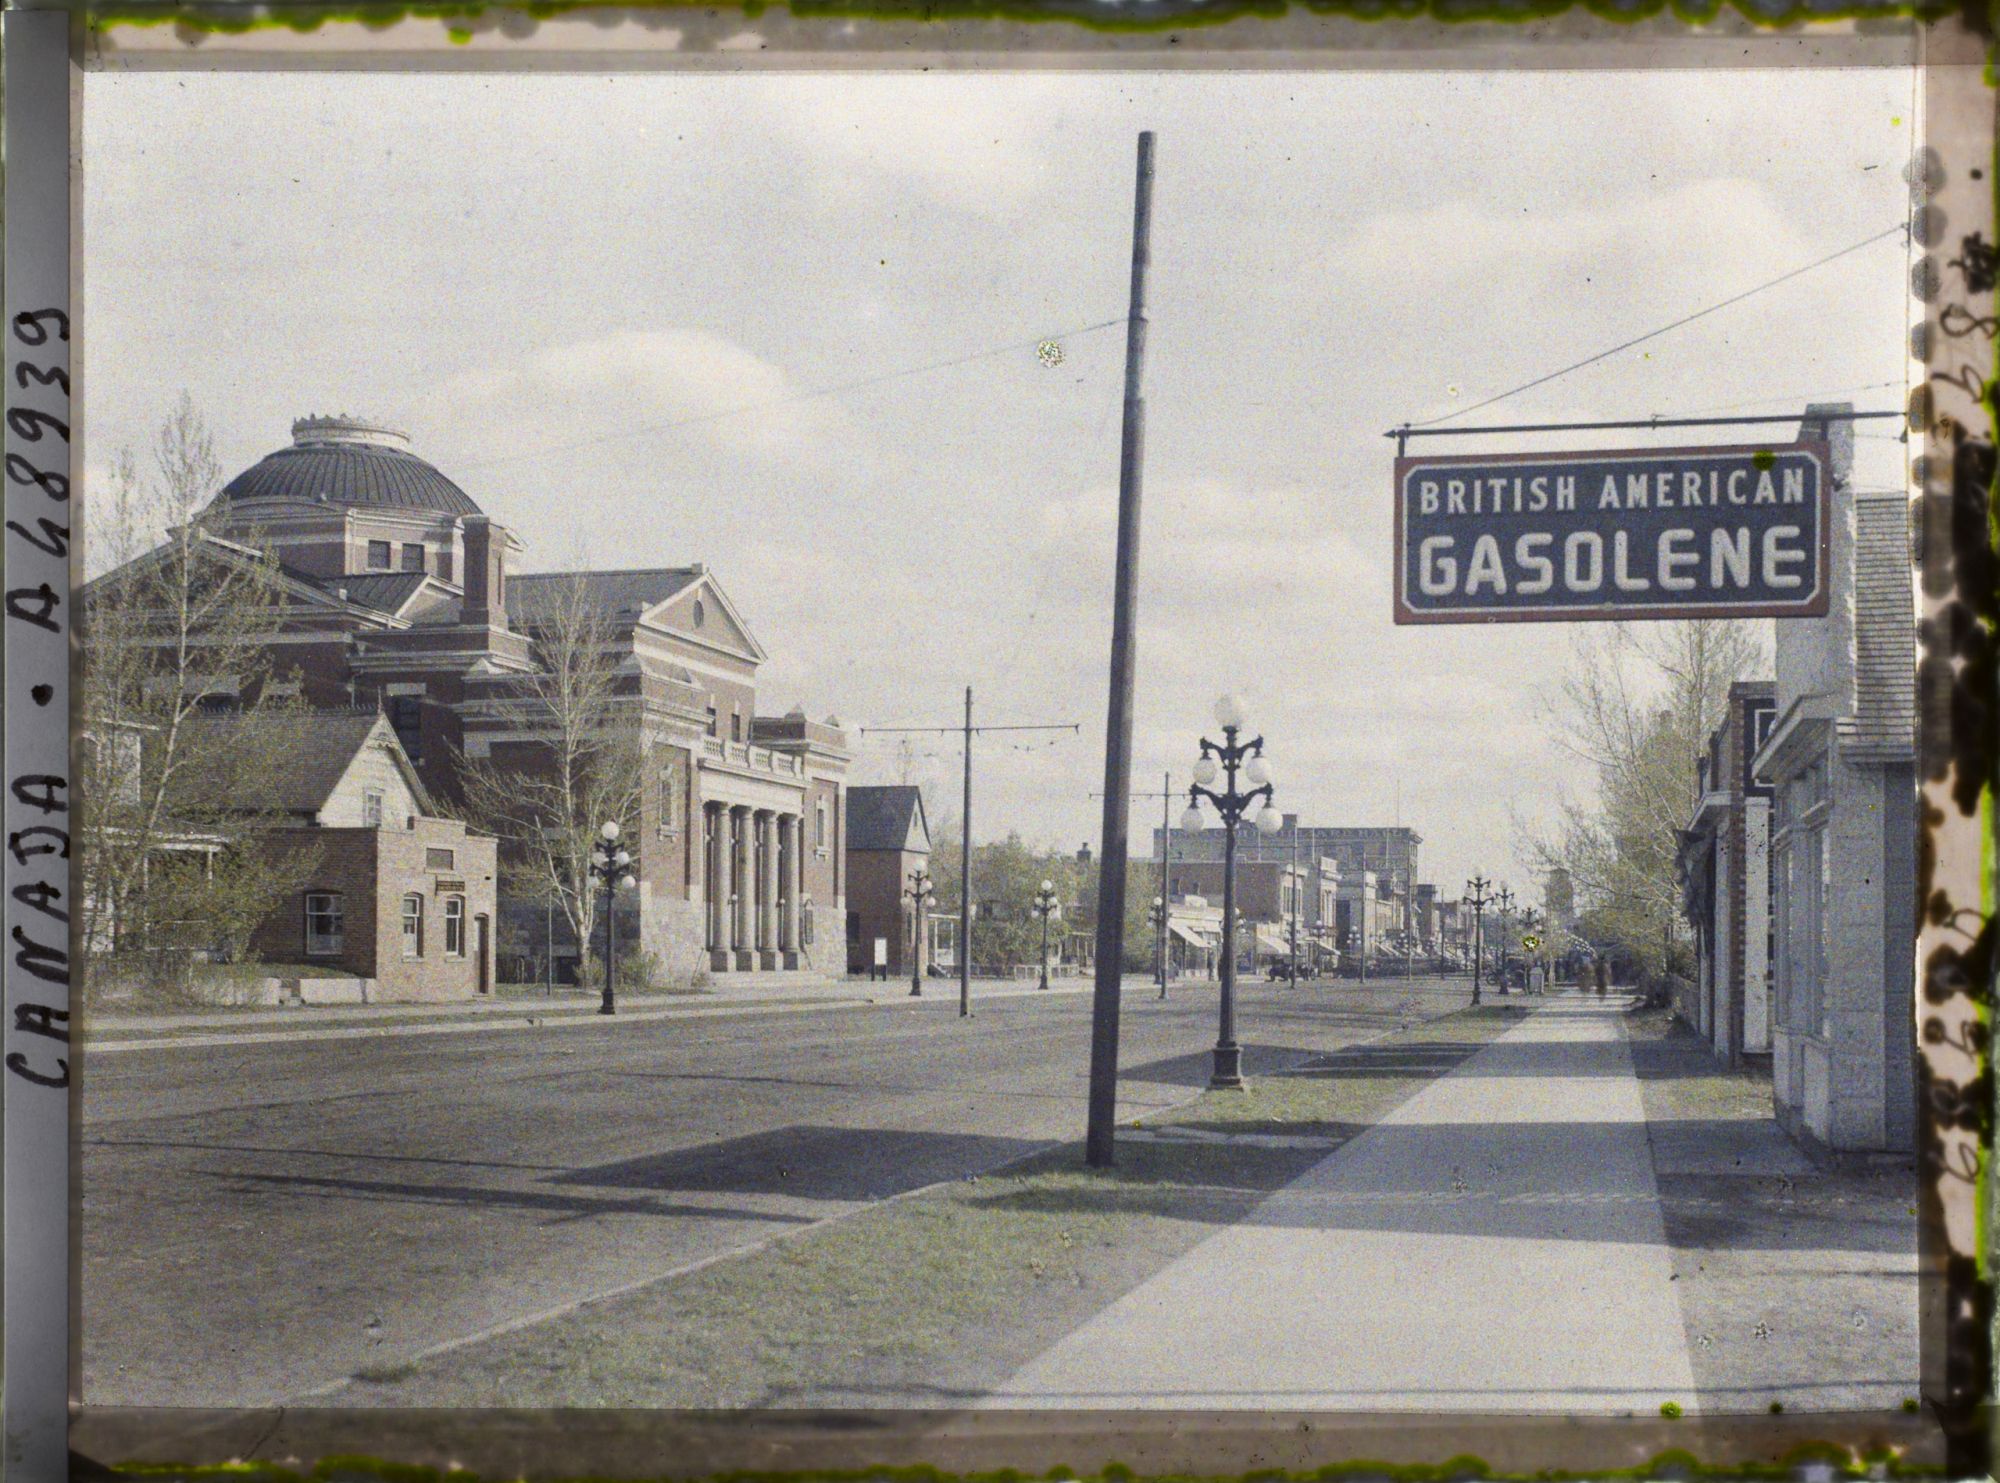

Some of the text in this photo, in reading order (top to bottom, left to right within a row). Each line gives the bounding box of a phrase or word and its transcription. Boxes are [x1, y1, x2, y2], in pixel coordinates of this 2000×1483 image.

[1420, 467, 1804, 515] BRITISH AMERICAN
[1419, 525, 1806, 596] GASOLENE
[6, 774, 70, 1089] CANADA
